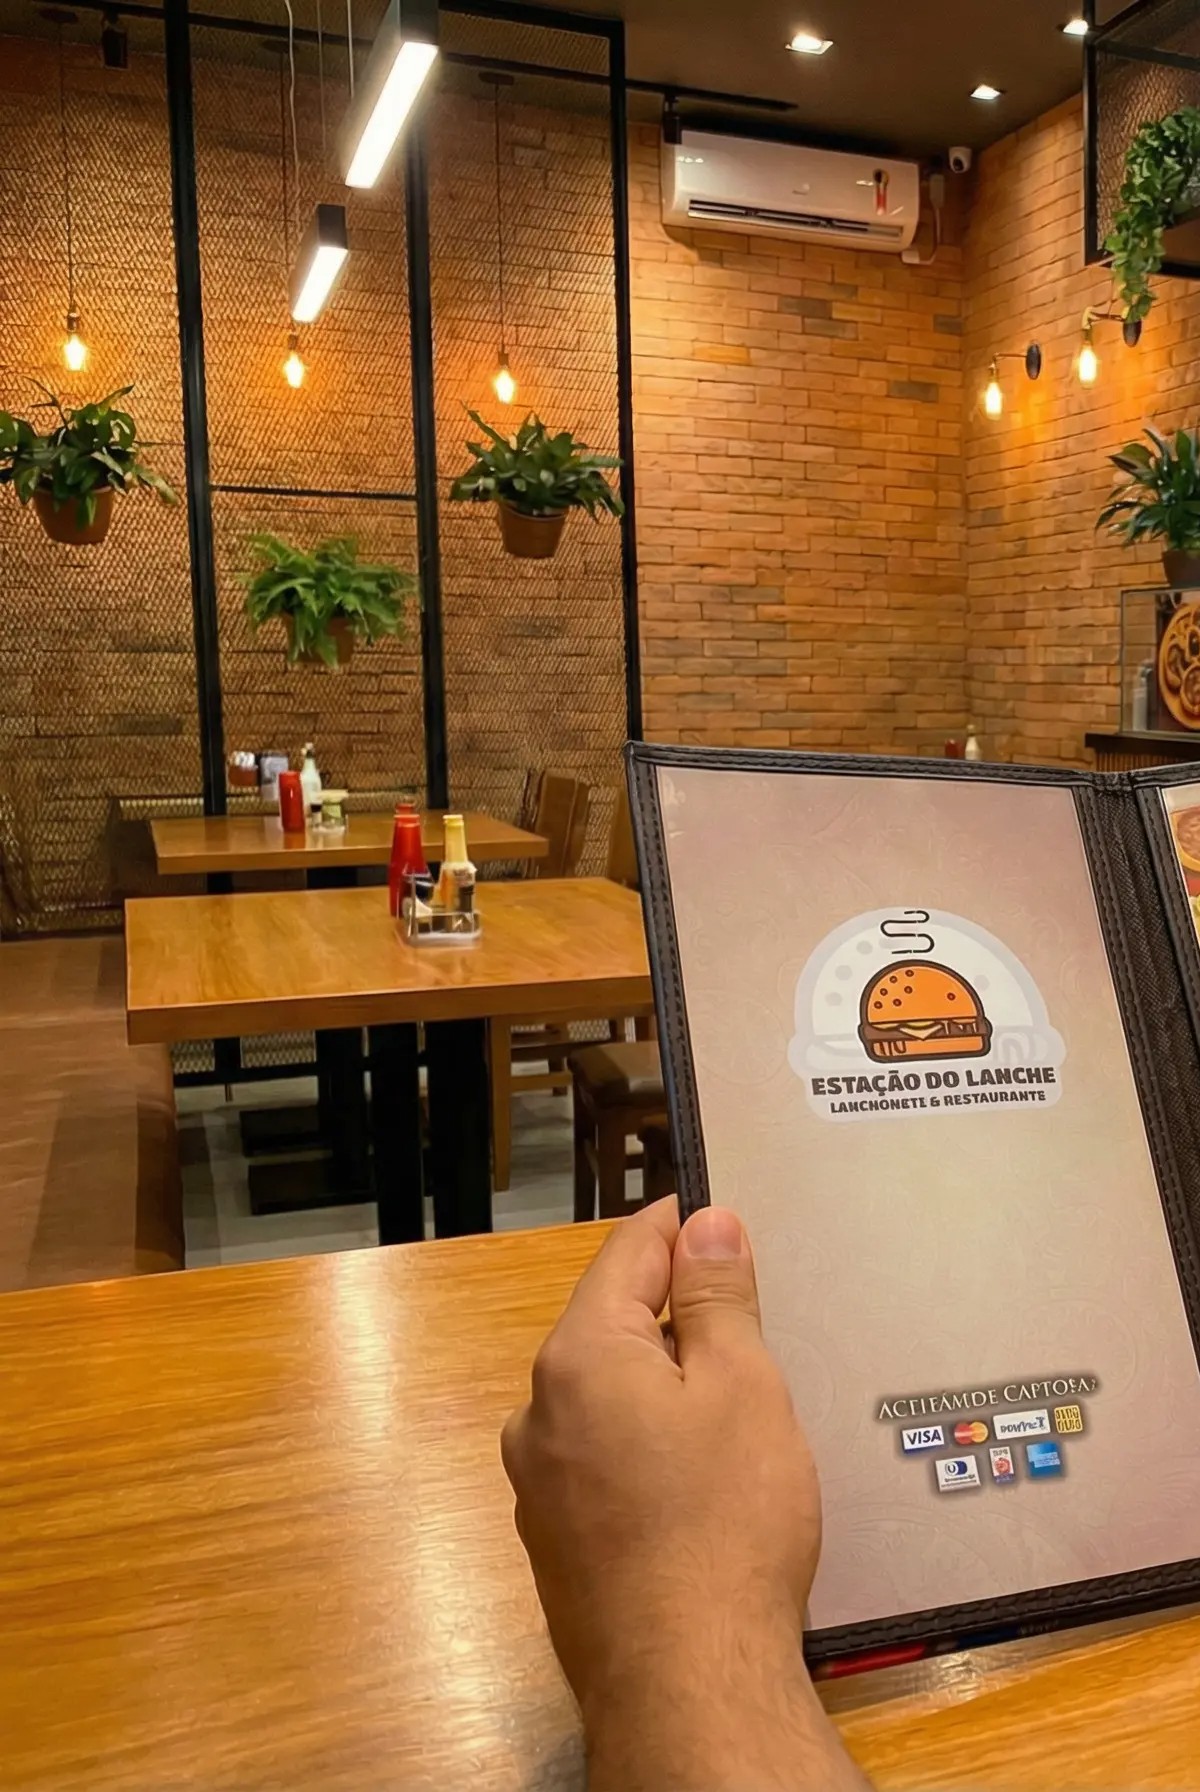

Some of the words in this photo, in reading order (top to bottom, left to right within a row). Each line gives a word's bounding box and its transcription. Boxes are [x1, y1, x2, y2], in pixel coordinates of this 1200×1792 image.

[811, 1070, 921, 1096] ESTAÇÃO
[924, 1071, 959, 1090] DO
[966, 1067, 1056, 1086] LANCHE
[930, 1096, 940, 1107] &
[943, 1090, 1046, 1106] RESTAURANTE
[906, 1429, 942, 1445] VISA
